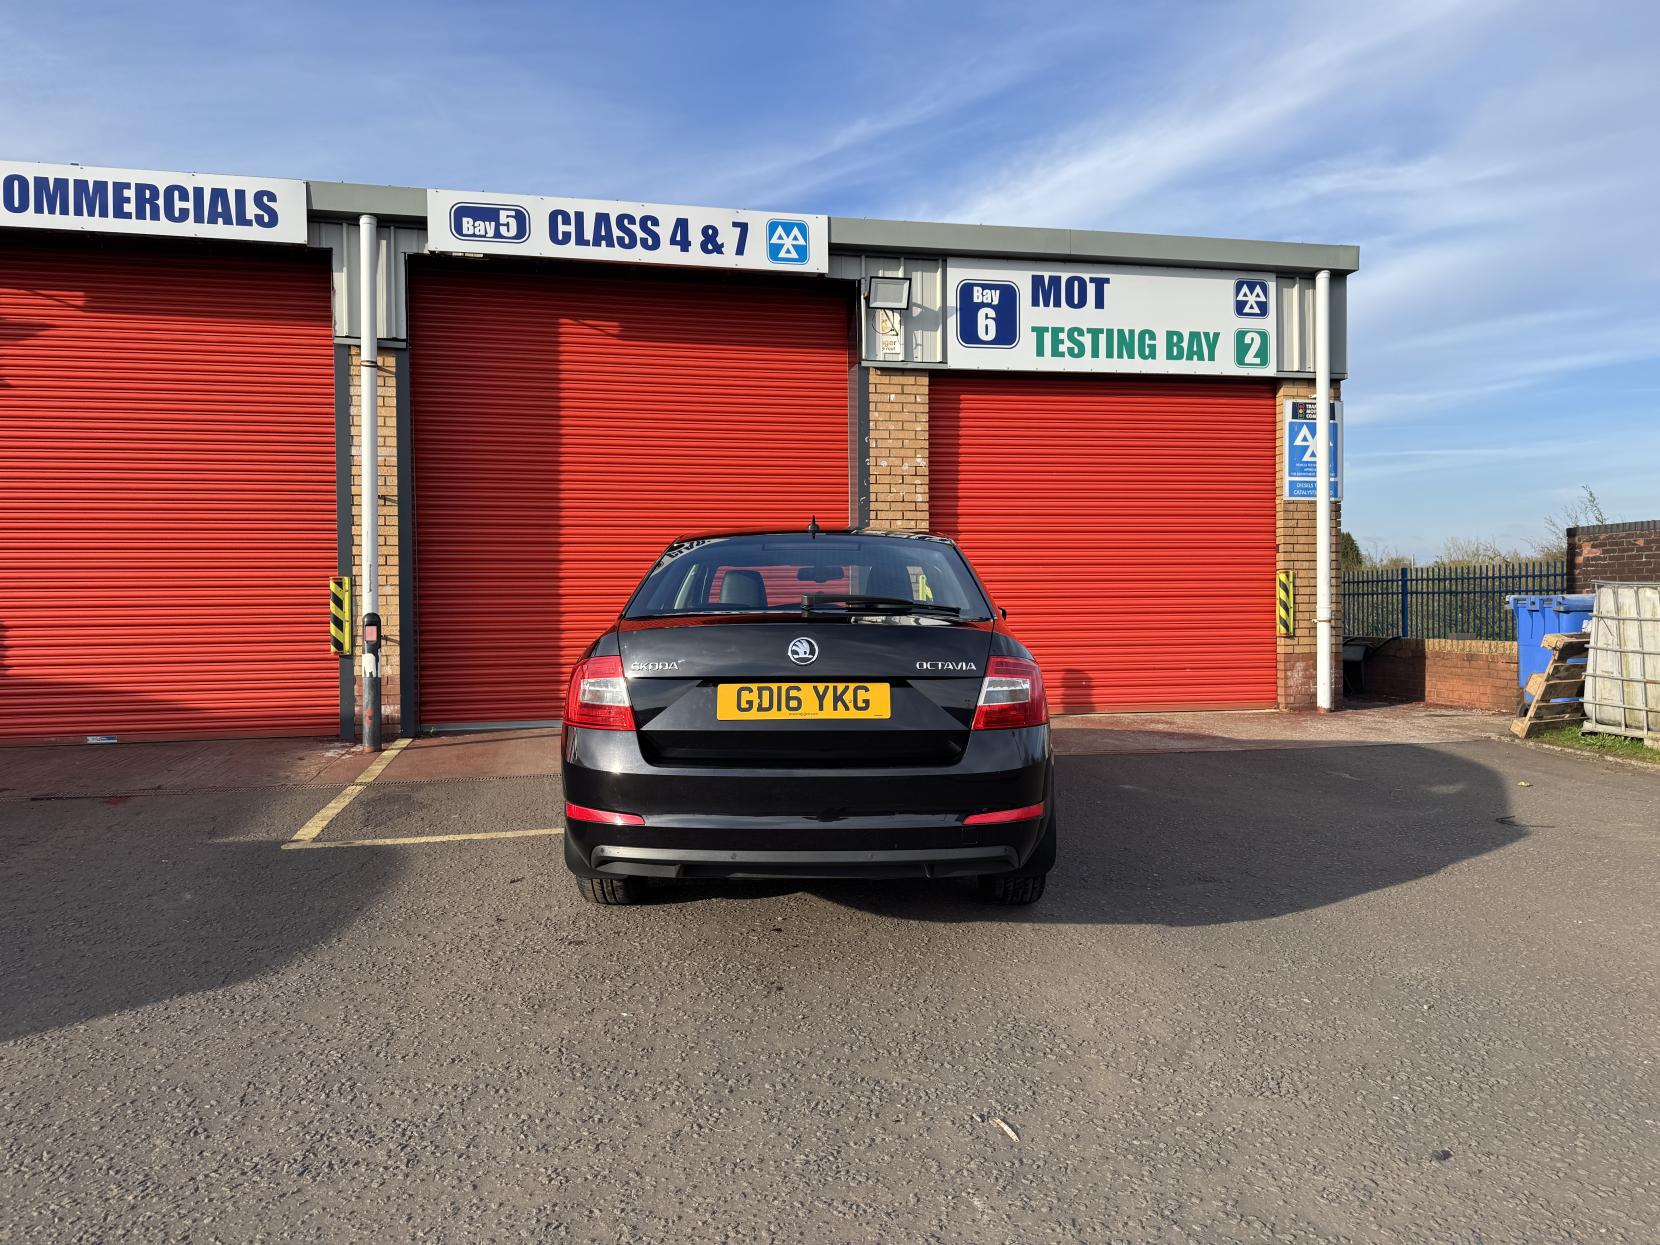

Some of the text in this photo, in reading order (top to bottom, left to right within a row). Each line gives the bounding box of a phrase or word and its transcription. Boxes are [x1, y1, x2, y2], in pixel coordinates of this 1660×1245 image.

[462, 209, 518, 238] Bay 5
[548, 208, 749, 257] CLASS 4 & 7
[973, 286, 1000, 306] Bay
[1031, 274, 1111, 310] MOT
[977, 307, 997, 342] 6
[1030, 325, 1221, 362] TESTING BAY
[1244, 331, 1262, 365] 2
[916, 661, 977, 671] OCTAVIA
[736, 684, 871, 713] GD16 YKG
